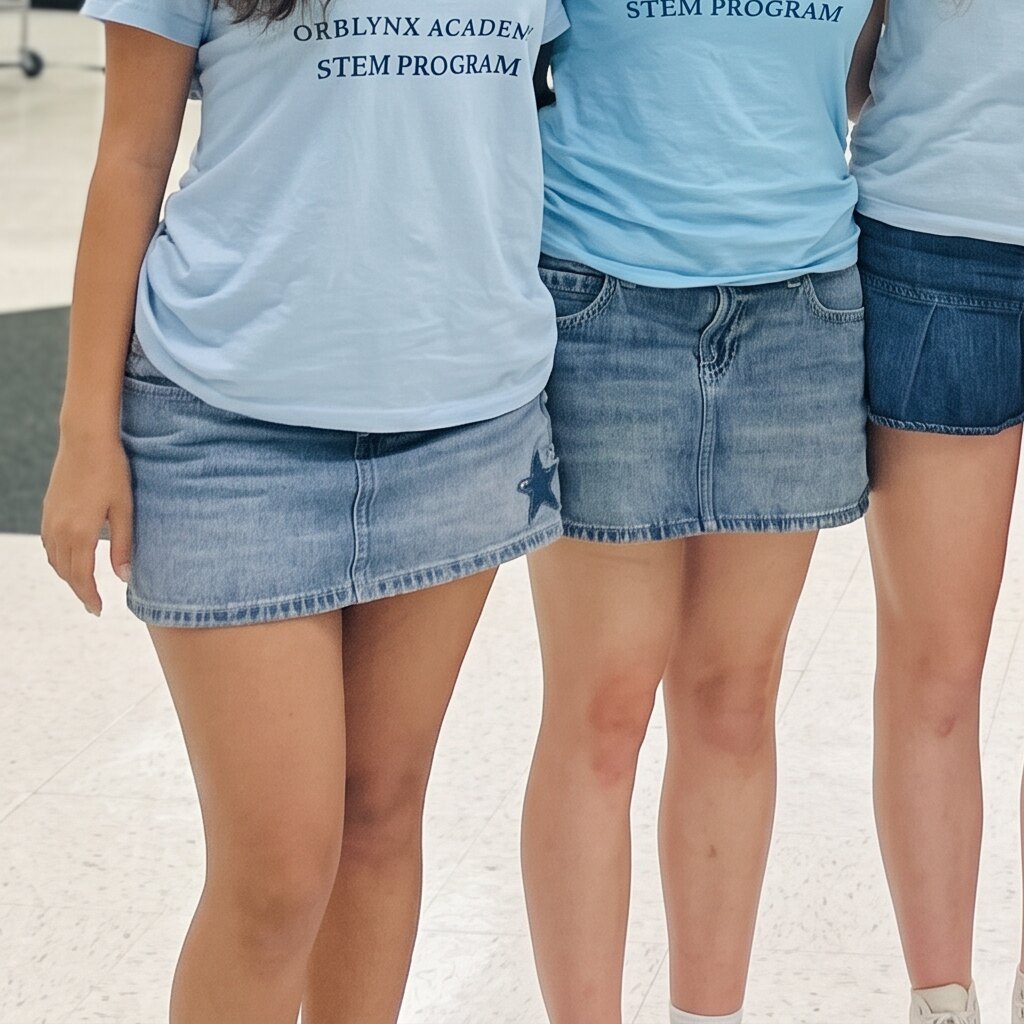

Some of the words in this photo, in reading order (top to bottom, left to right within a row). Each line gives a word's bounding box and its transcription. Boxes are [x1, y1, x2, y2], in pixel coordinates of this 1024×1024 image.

[293, 16, 421, 42] ORBLYNX
[317, 54, 391, 80] STEM
[396, 53, 522, 77] PROGRAM
